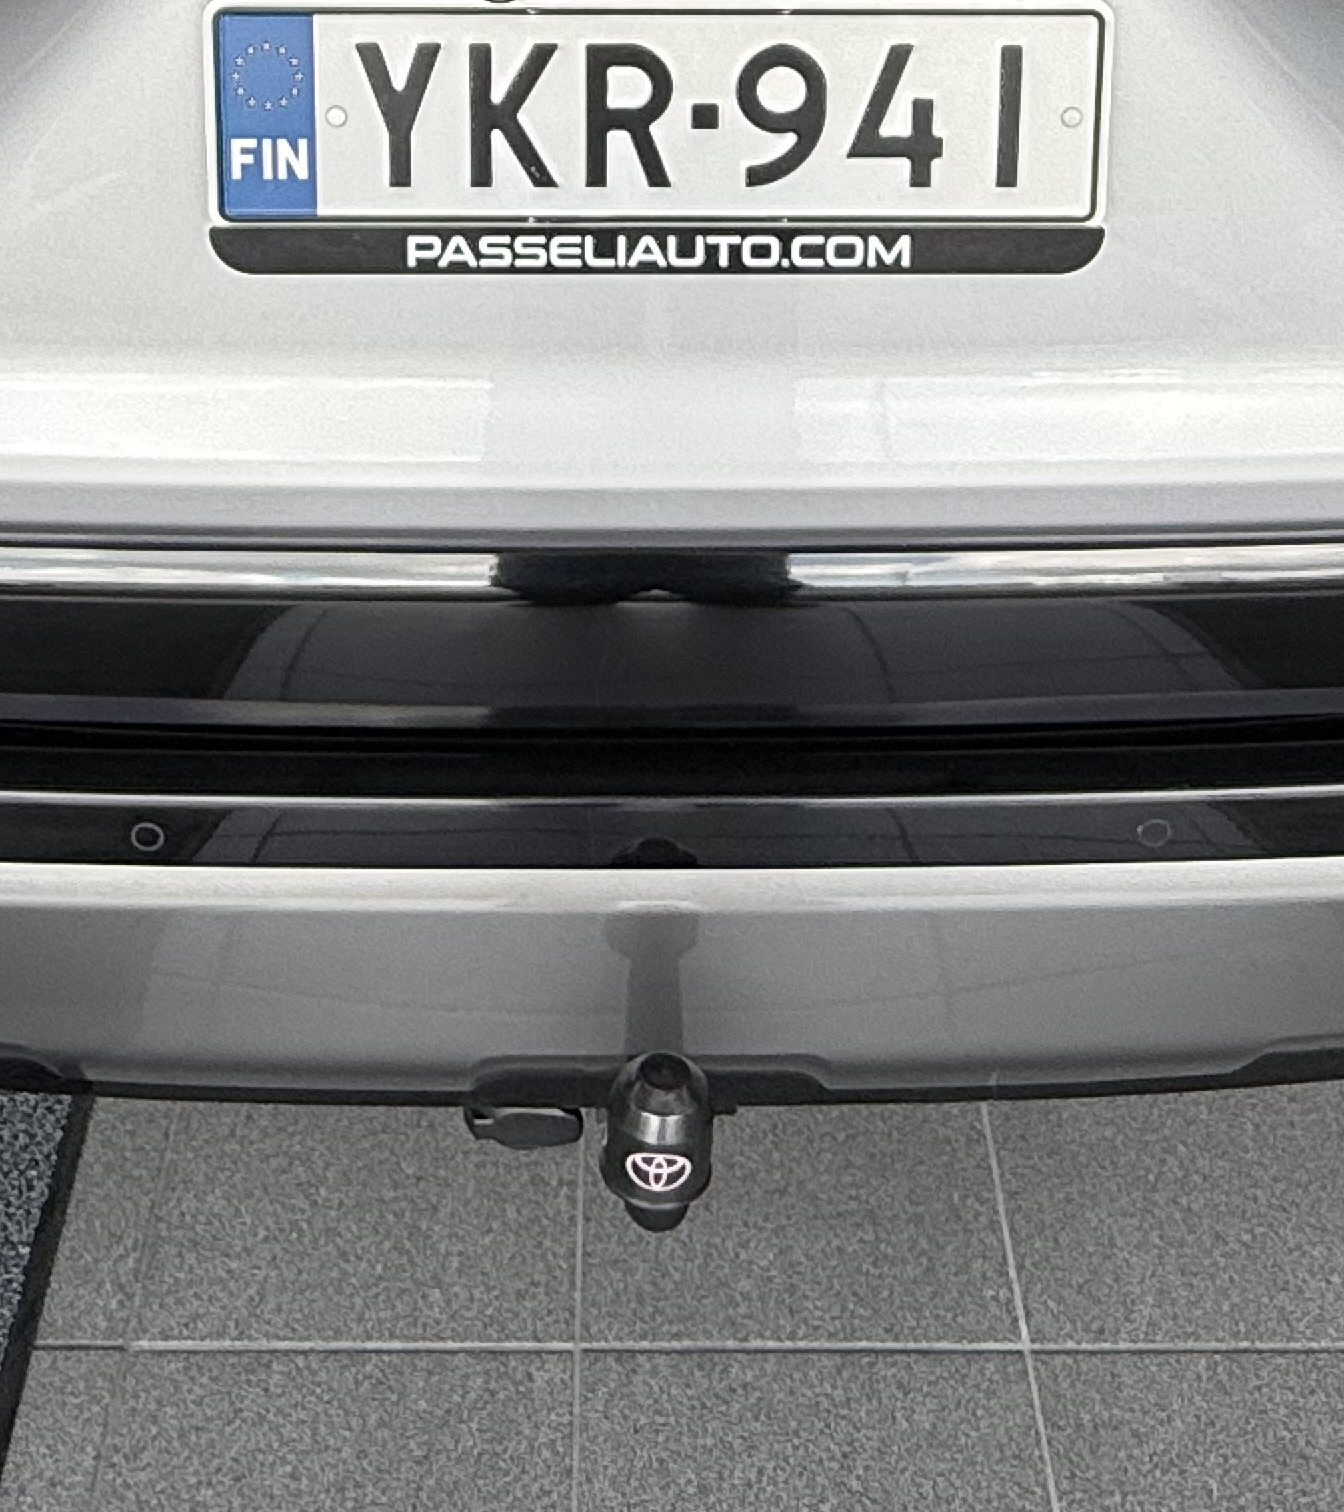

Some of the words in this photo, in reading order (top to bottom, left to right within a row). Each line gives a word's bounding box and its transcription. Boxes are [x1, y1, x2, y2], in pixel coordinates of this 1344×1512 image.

[355, 43, 1026, 188] YKR-941
[230, 138, 309, 180] FIN
[406, 234, 912, 268] PASSELIAUTO.COM
